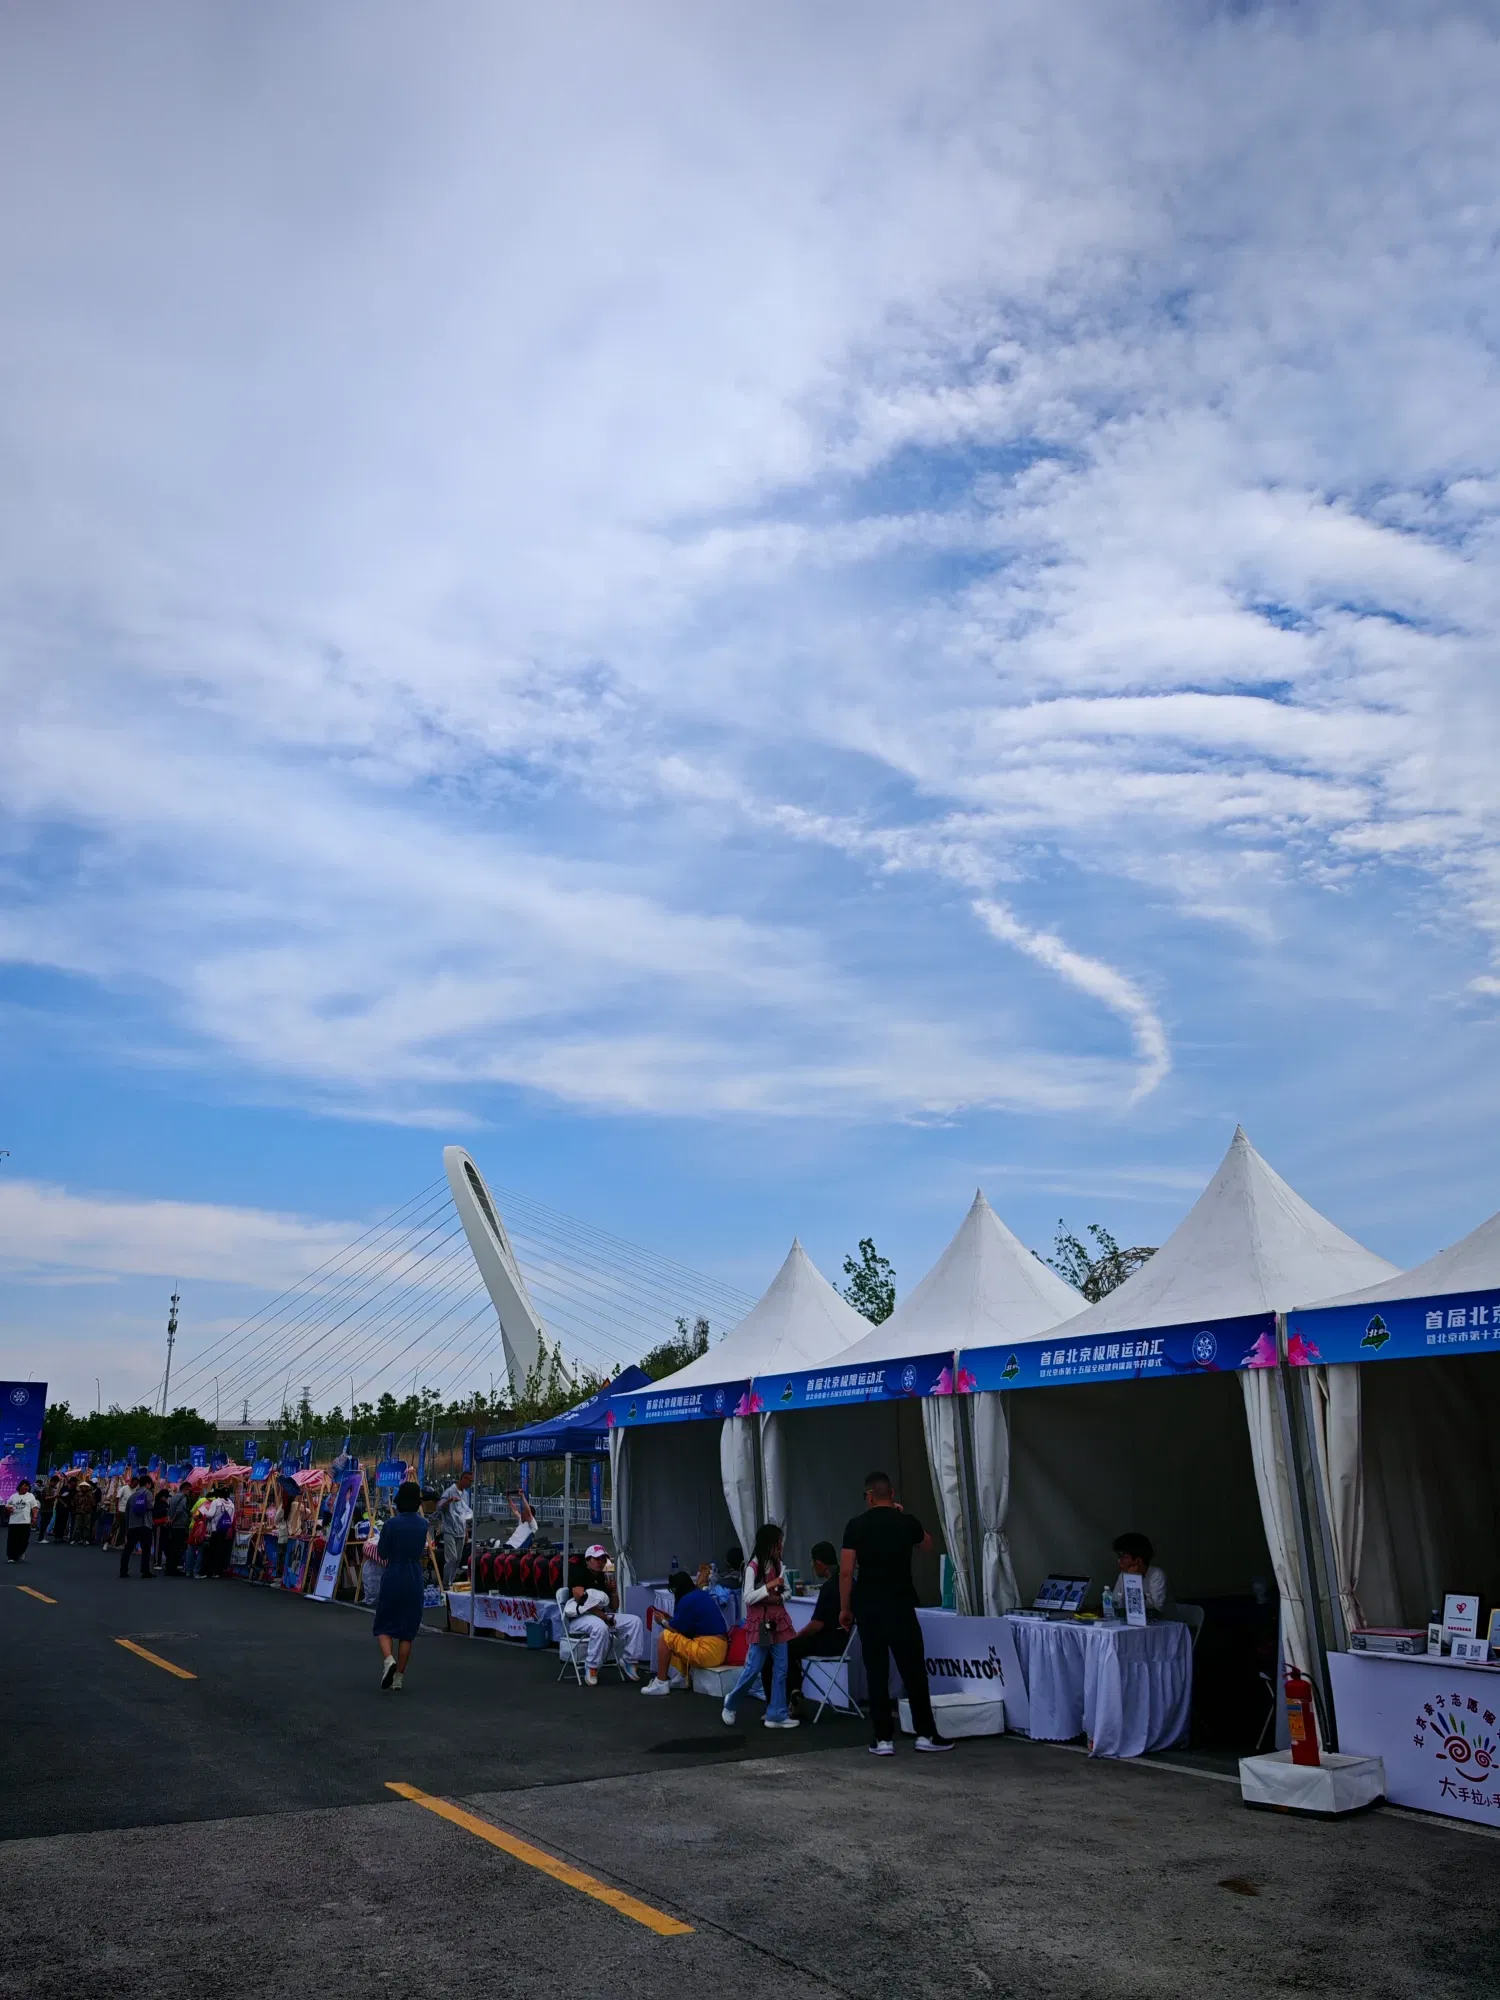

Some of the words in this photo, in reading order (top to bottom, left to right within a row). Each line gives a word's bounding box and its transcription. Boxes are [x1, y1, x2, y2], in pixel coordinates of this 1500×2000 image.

[1040, 1338, 1165, 1366] 首届北京极限运动汇
[806, 1370, 886, 1392] 首届北京极限运动汇
[1413, 1692, 1500, 1749] 北京亲子志愿服
